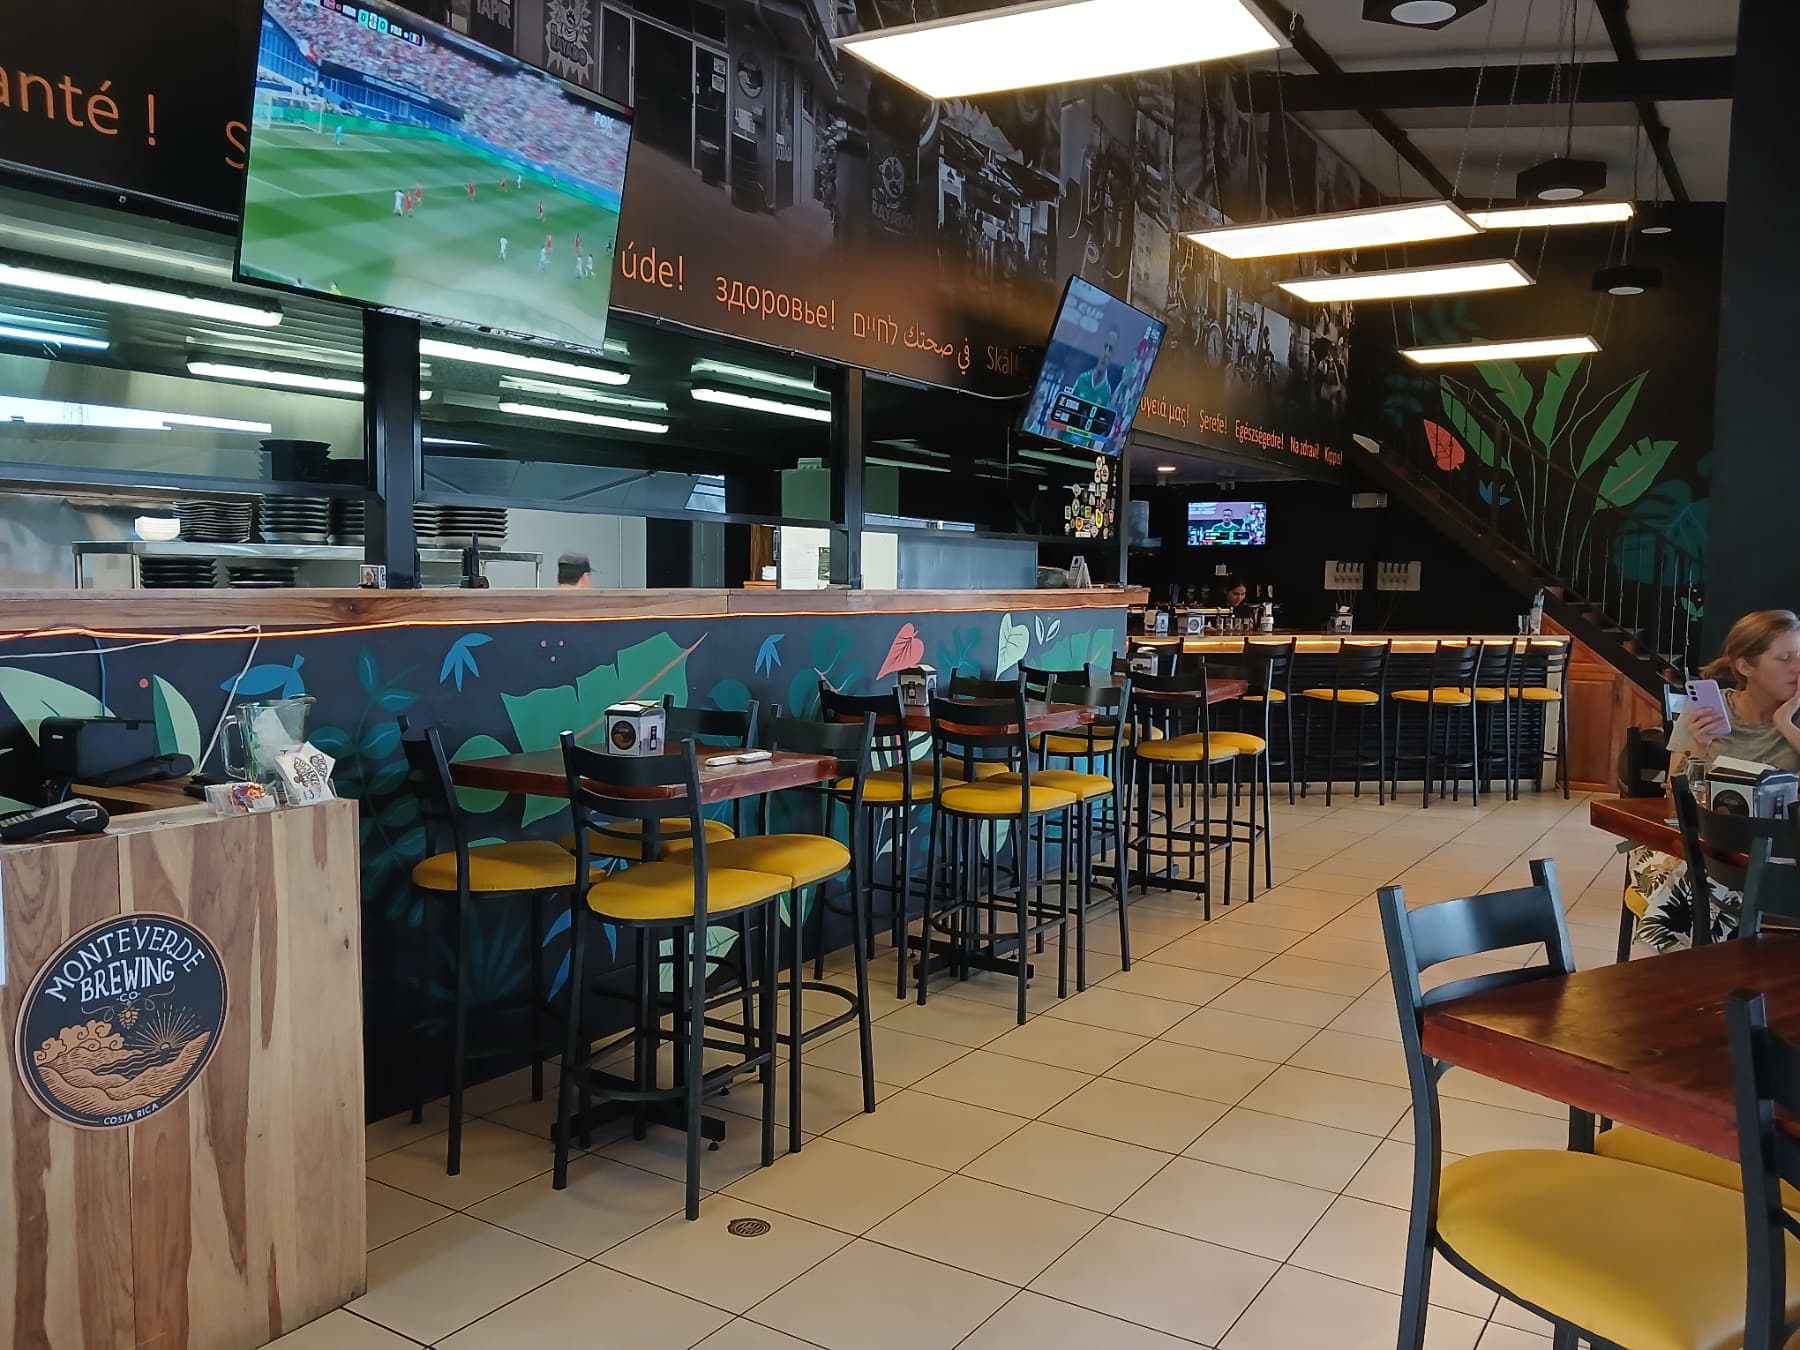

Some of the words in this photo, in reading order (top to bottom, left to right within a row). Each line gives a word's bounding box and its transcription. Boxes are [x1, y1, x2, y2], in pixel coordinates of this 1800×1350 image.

[715, 275, 836, 331] здоровье!
[853, 312, 898, 345] לחיים
[903, 321, 954, 358] صحتك
[957, 337, 971, 375] في
[45, 925, 206, 1003] MONTEVERDE
[80, 956, 175, 1003] BREWING
[103, 1112, 134, 1126] COSTA
[136, 1102, 159, 1118] RICA
